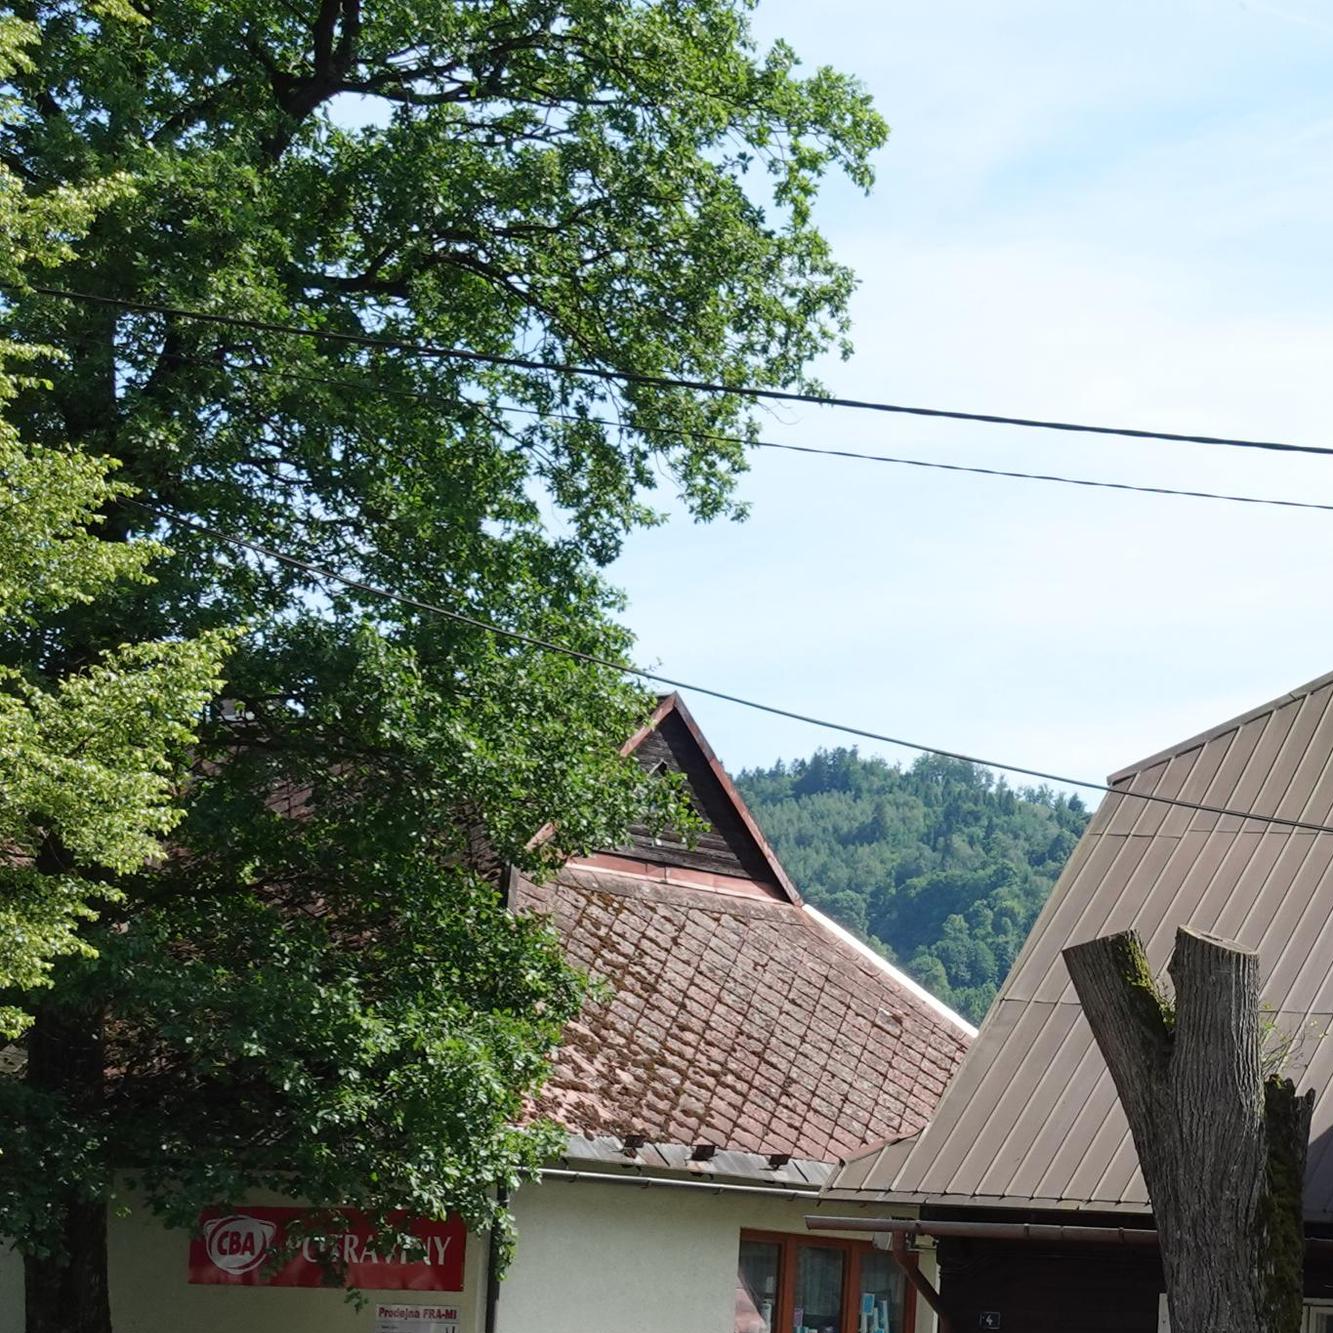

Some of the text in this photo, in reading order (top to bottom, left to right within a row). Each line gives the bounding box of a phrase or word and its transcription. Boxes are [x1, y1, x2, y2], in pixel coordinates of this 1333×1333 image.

[216, 1230, 255, 1256] CBA
[378, 1307, 457, 1320] Prodejna FRA-MI
[986, 1314, 993, 1326] 4
